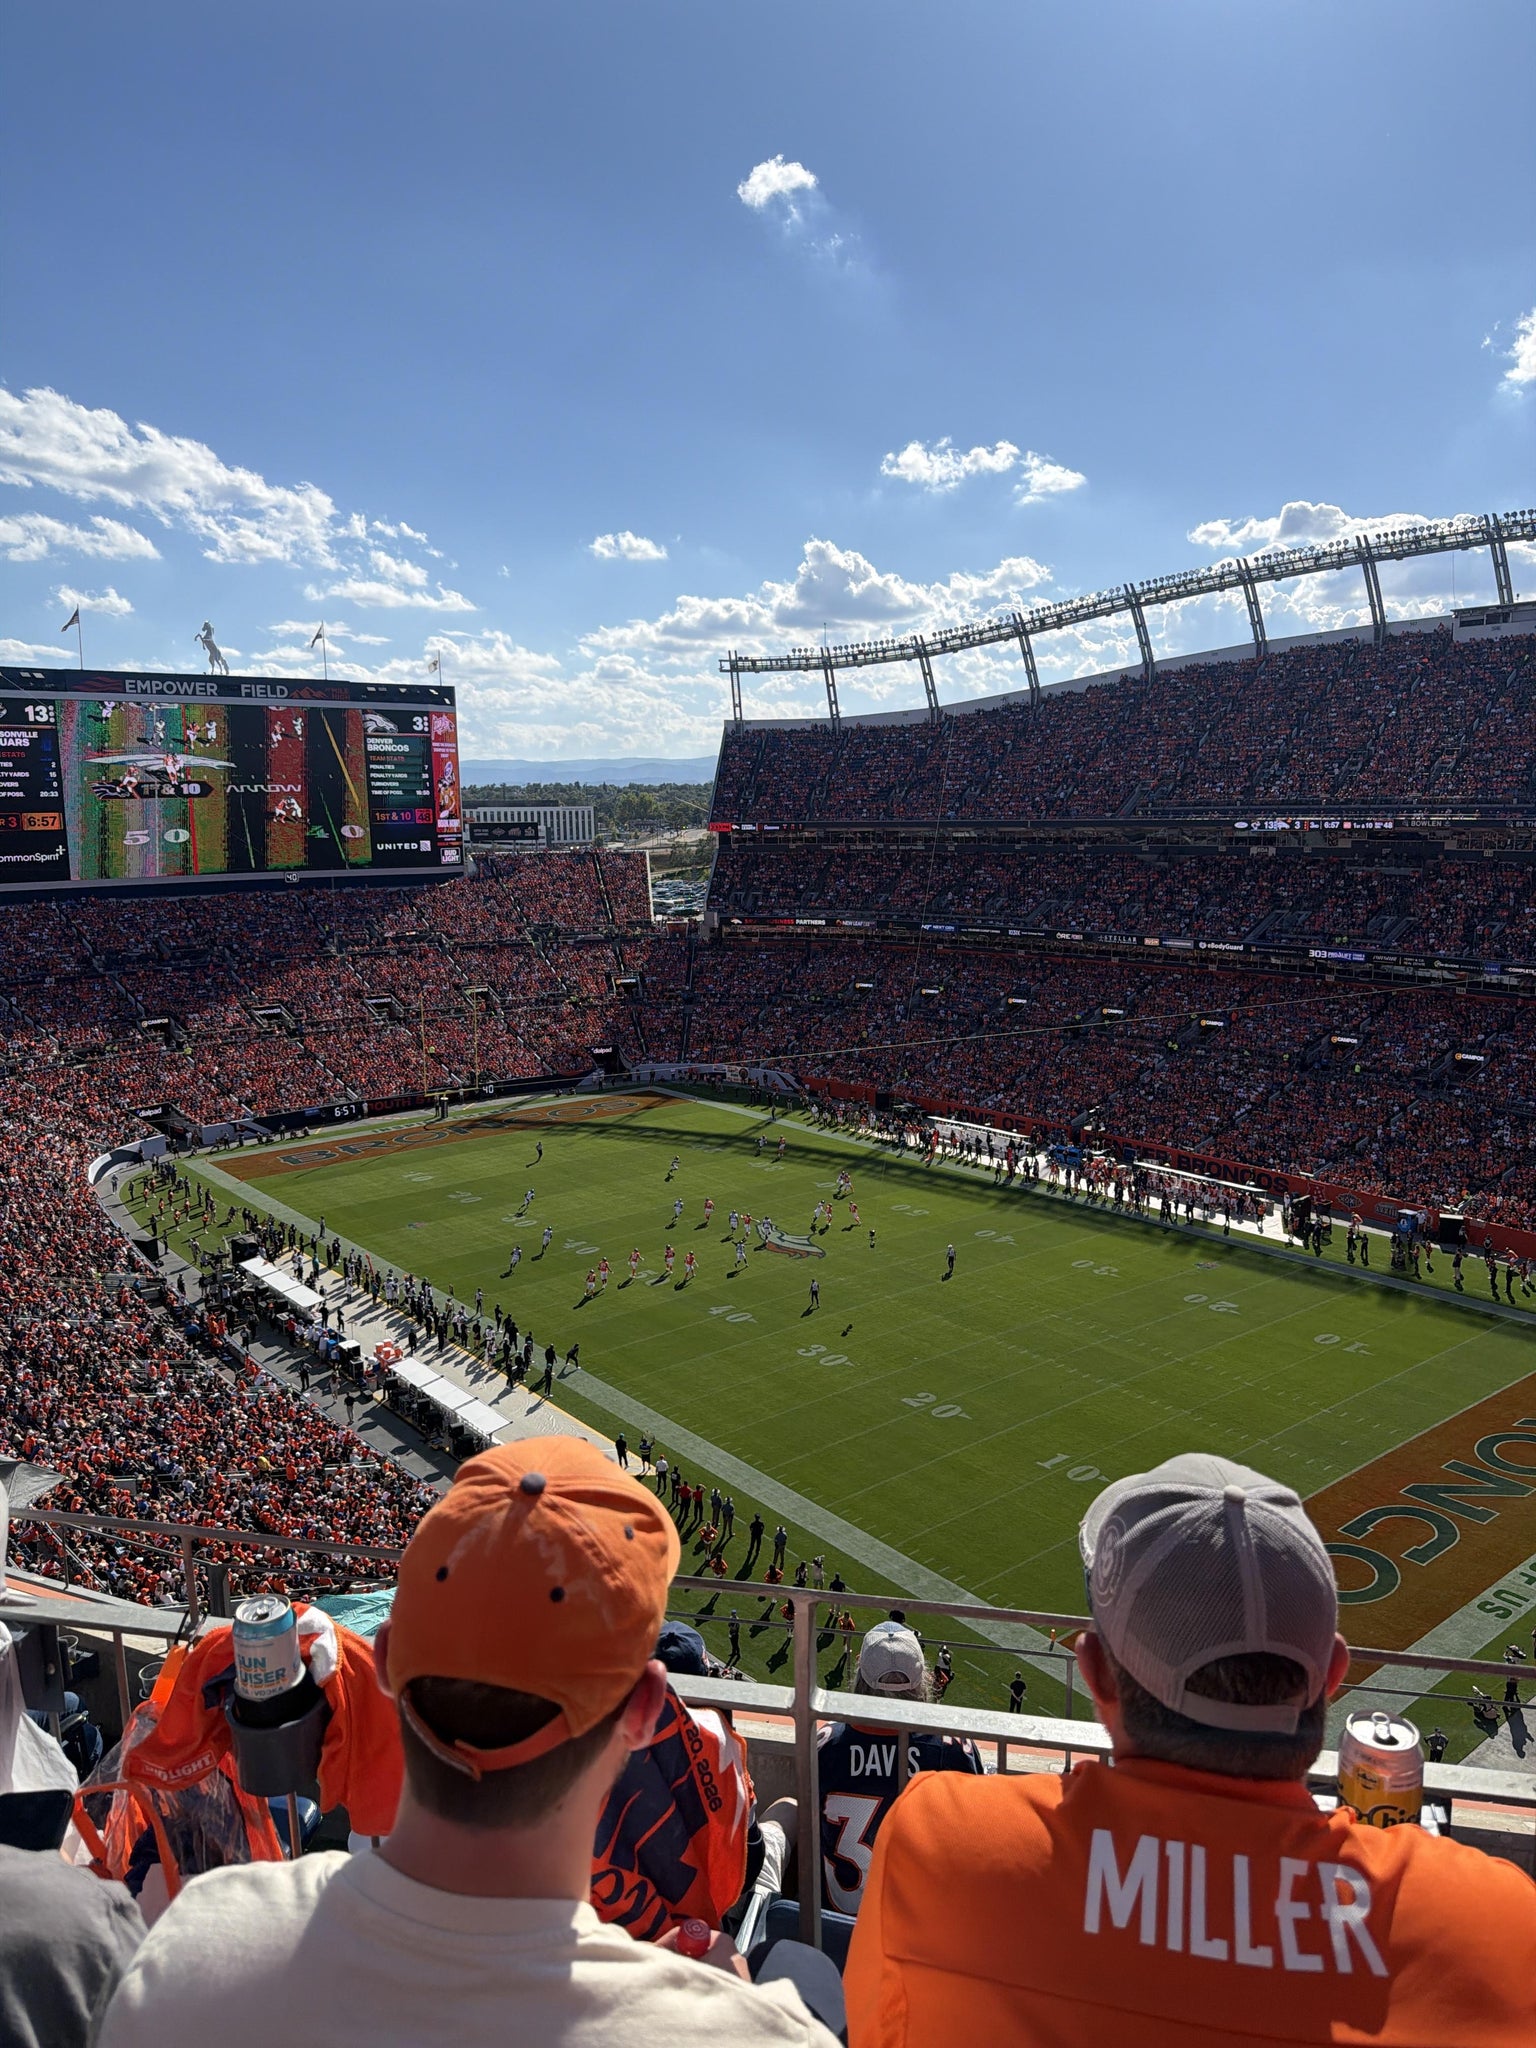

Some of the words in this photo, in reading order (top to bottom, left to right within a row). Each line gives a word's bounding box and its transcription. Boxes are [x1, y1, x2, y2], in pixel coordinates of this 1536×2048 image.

[125, 679, 218, 696] EMPOWER
[240, 684, 288, 699] FIELD
[24, 705, 49, 722] 13
[412, 716, 423, 731] 3
[181, 783, 200, 794] 10
[8, 816, 17, 828] 3
[27, 816, 57, 827] 6:57
[375, 812, 390, 820] 1ST
[391, 812, 398, 820] &
[400, 812, 411, 820] 10
[1264, 821, 1274, 829] 13
[1294, 821, 1300, 829] 3
[1323, 821, 1340, 829] 6:57
[286, 873, 298, 881] 40
[1207, 943, 1244, 952] eBodyGuard
[1308, 949, 1327, 958] 303
[1337, 1036, 1358, 1044] CAMPOS
[593, 1046, 612, 1054] dialpad
[1461, 1053, 1484, 1061] CAMPOS
[482, 1084, 494, 1094] 40
[138, 1107, 162, 1117] dialpad
[334, 1104, 356, 1118] 6:57
[1003, 1117, 1026, 1130] OF
[276, 1100, 641, 1166] BRONCOS
[402, 1170, 435, 1182] 10
[1178, 1154, 1289, 1193] BRONCOS
[890, 1204, 930, 1217] 50
[563, 1238, 600, 1255] 40
[1071, 1259, 1114, 1277] 30
[1183, 1293, 1236, 1312] 20
[708, 1304, 753, 1323] 40
[1313, 1333, 1367, 1354] 10
[796, 1344, 849, 1367] 30
[901, 1391, 964, 1419] 20
[1036, 1452, 1102, 1482] 10
[1476, 1588, 1531, 1620] US
[254, 1686, 284, 1696] VODKA
[168, 1754, 211, 1779] LIGHT
[850, 1744, 921, 1778] DAVS
[1084, 1828, 1390, 1978] MILLER
